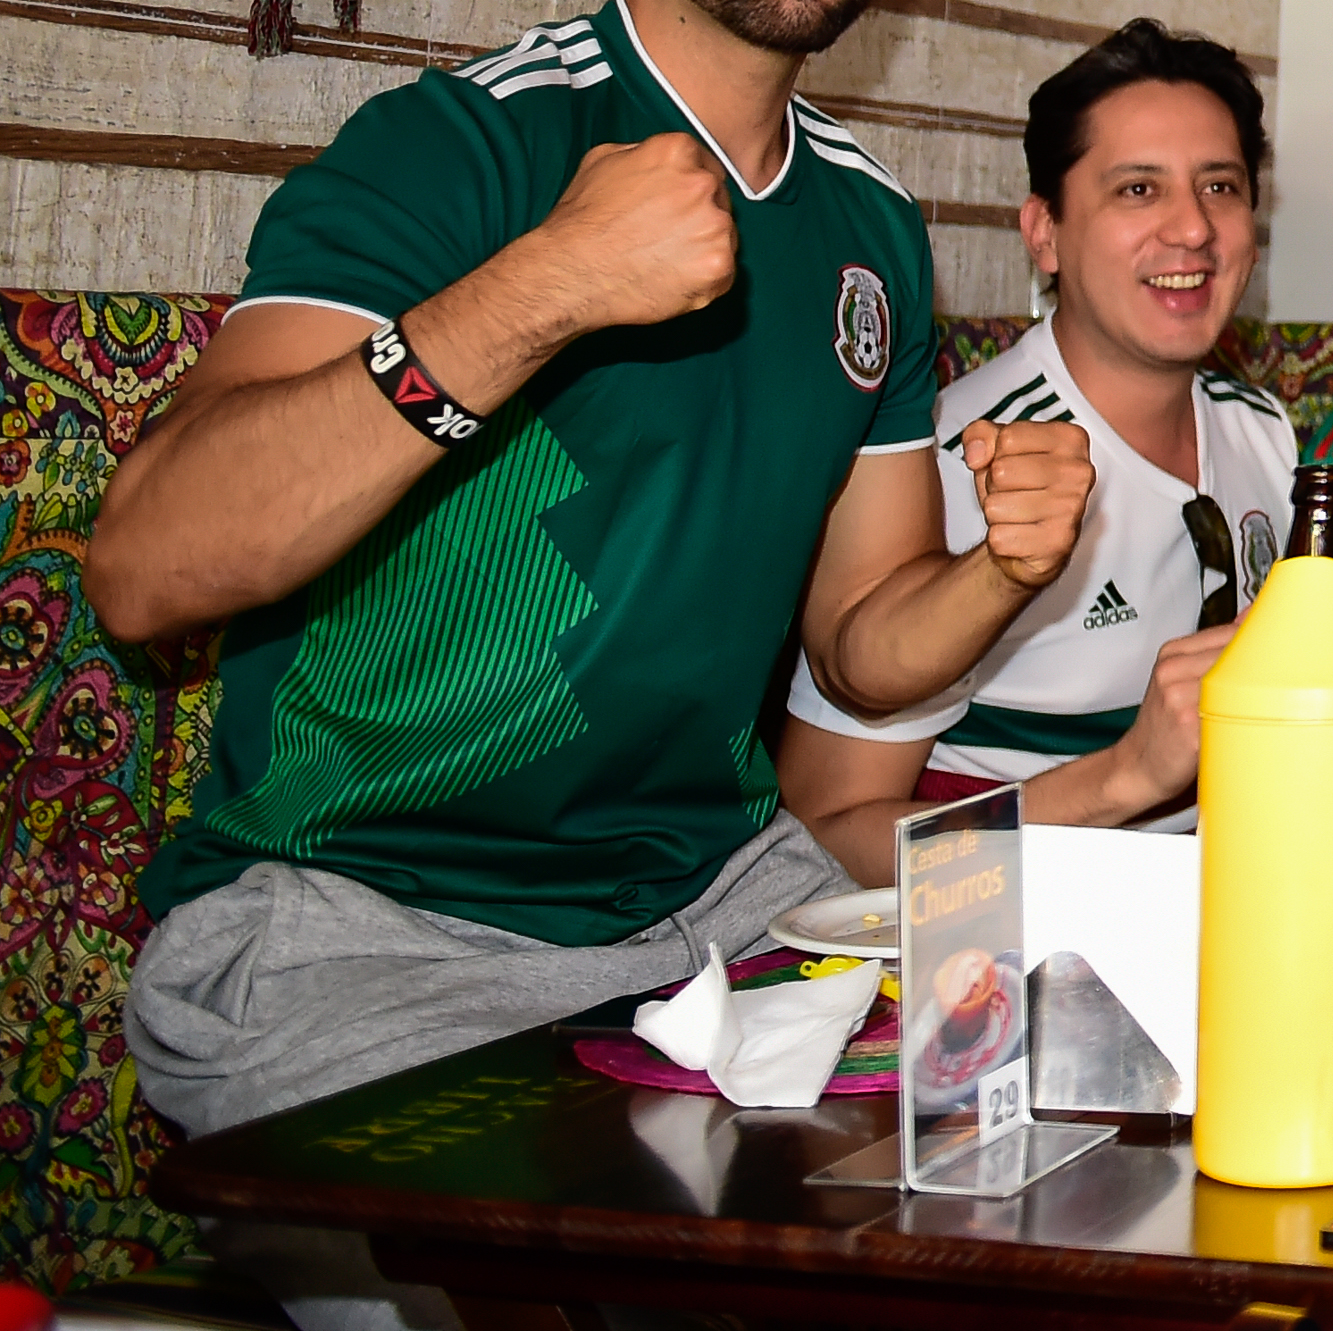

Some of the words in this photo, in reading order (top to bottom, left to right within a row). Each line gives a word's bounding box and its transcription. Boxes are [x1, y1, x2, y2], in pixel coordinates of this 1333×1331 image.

[426, 403, 479, 440] ok
[1083, 607, 1138, 631] adidas
[909, 842, 953, 875] Cesta
[957, 828, 979, 858] de
[909, 865, 1005, 926] Churros
[989, 1080, 1019, 1129] 29
